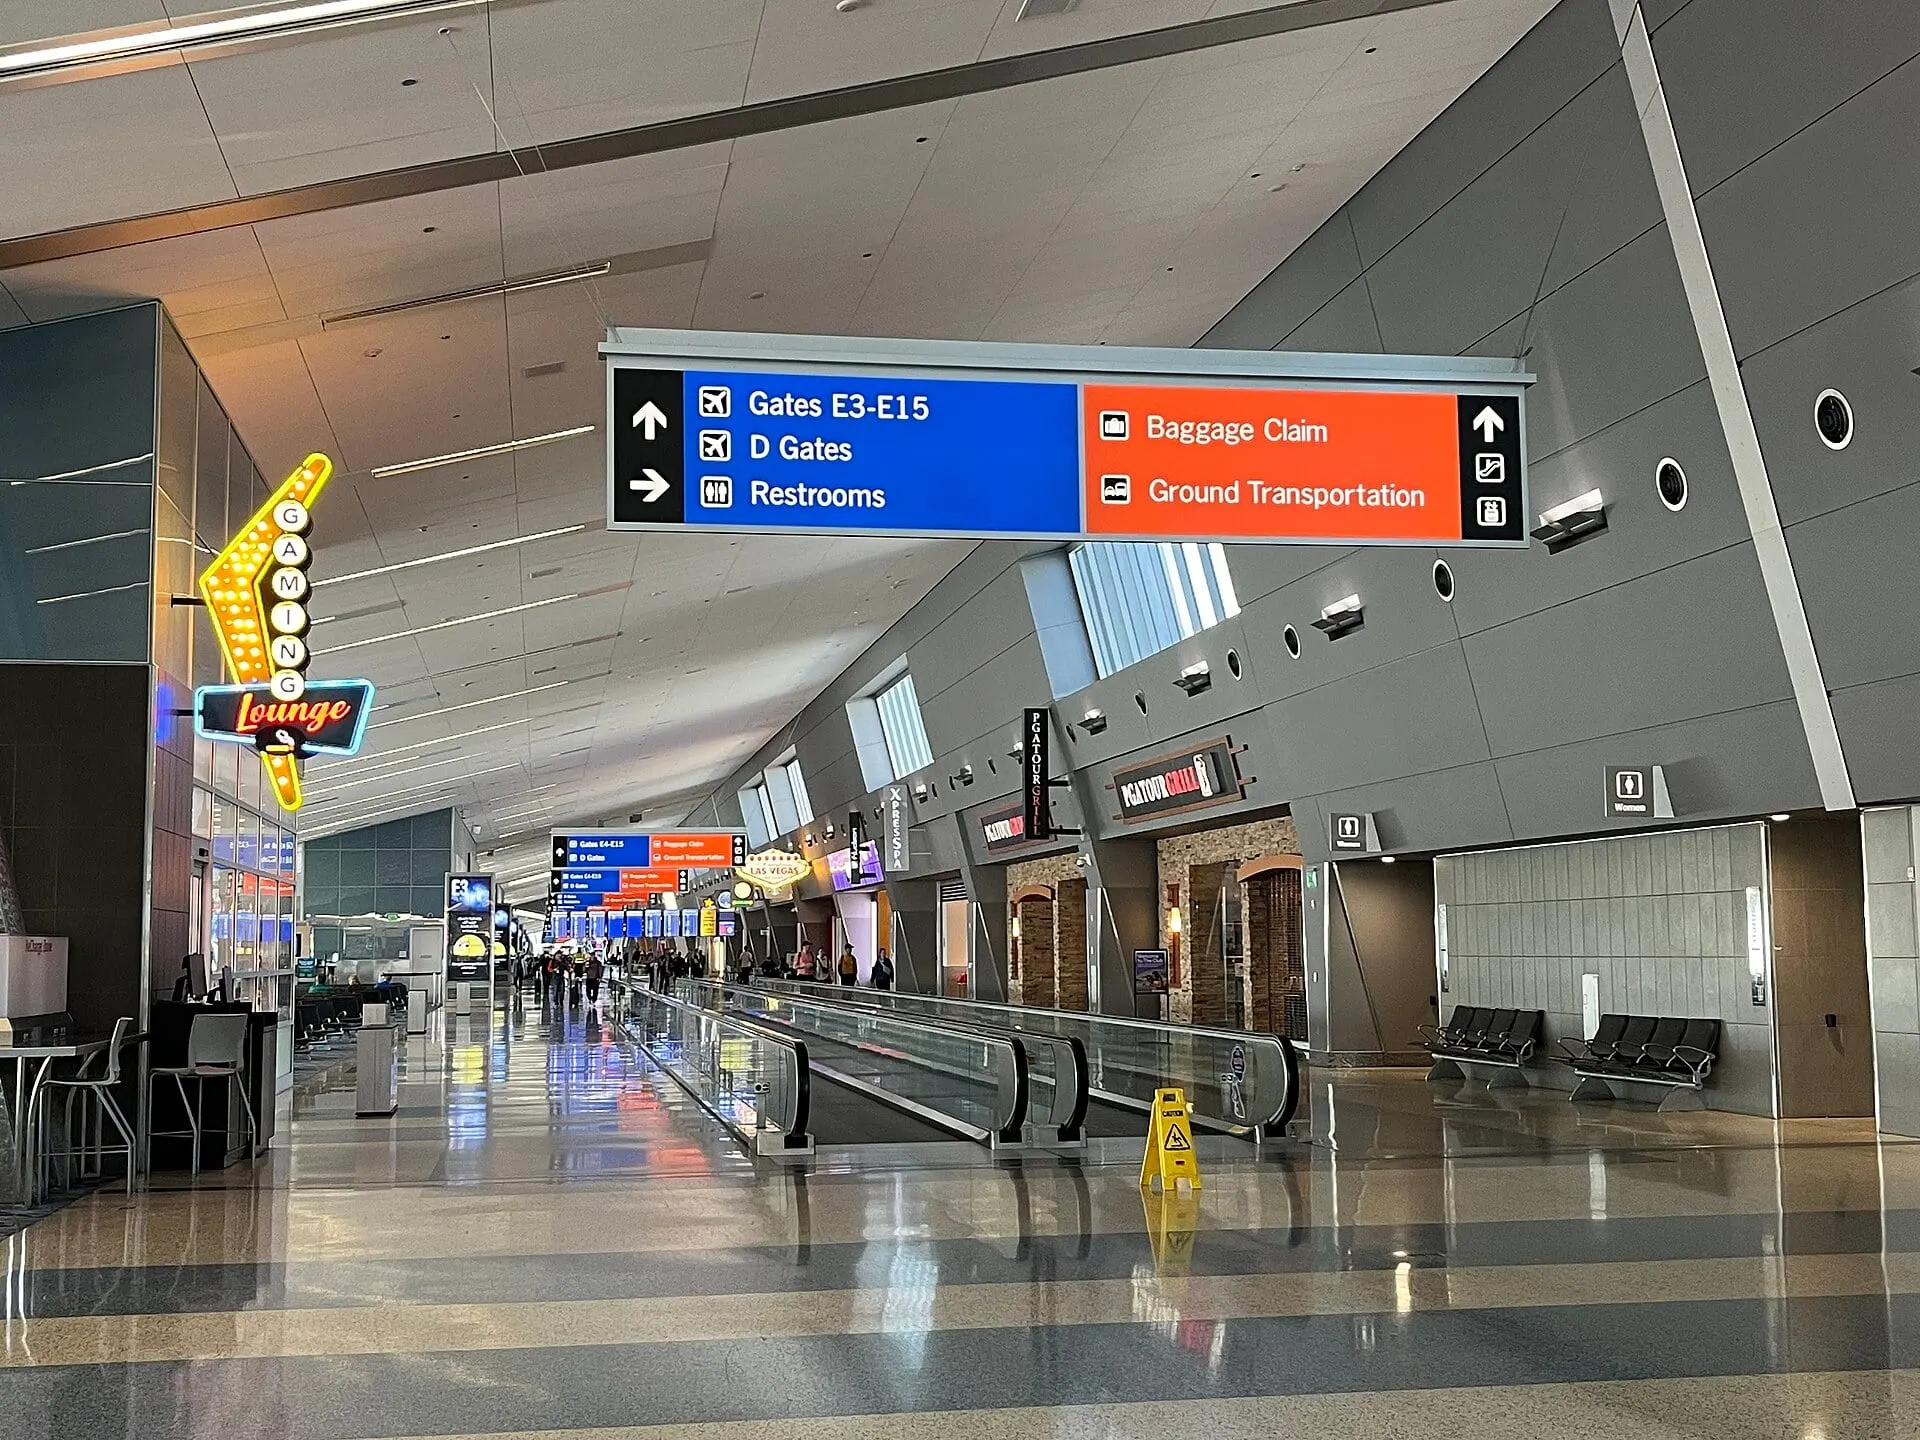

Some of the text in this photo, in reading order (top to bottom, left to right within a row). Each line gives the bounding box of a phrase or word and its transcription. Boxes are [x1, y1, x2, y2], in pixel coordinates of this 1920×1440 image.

[749, 390, 930, 421] Gates E3-E15
[1146, 414, 1328, 446] Baggage Claim
[750, 435, 852, 462] D Gates
[750, 481, 886, 508] Restrooms
[1149, 479, 1426, 510] Ground Transportation
[236, 692, 352, 732] Lounge
[1614, 802, 1647, 812] Women
[750, 867, 799, 875] LAS VEGAS
[451, 878, 469, 897] E3
